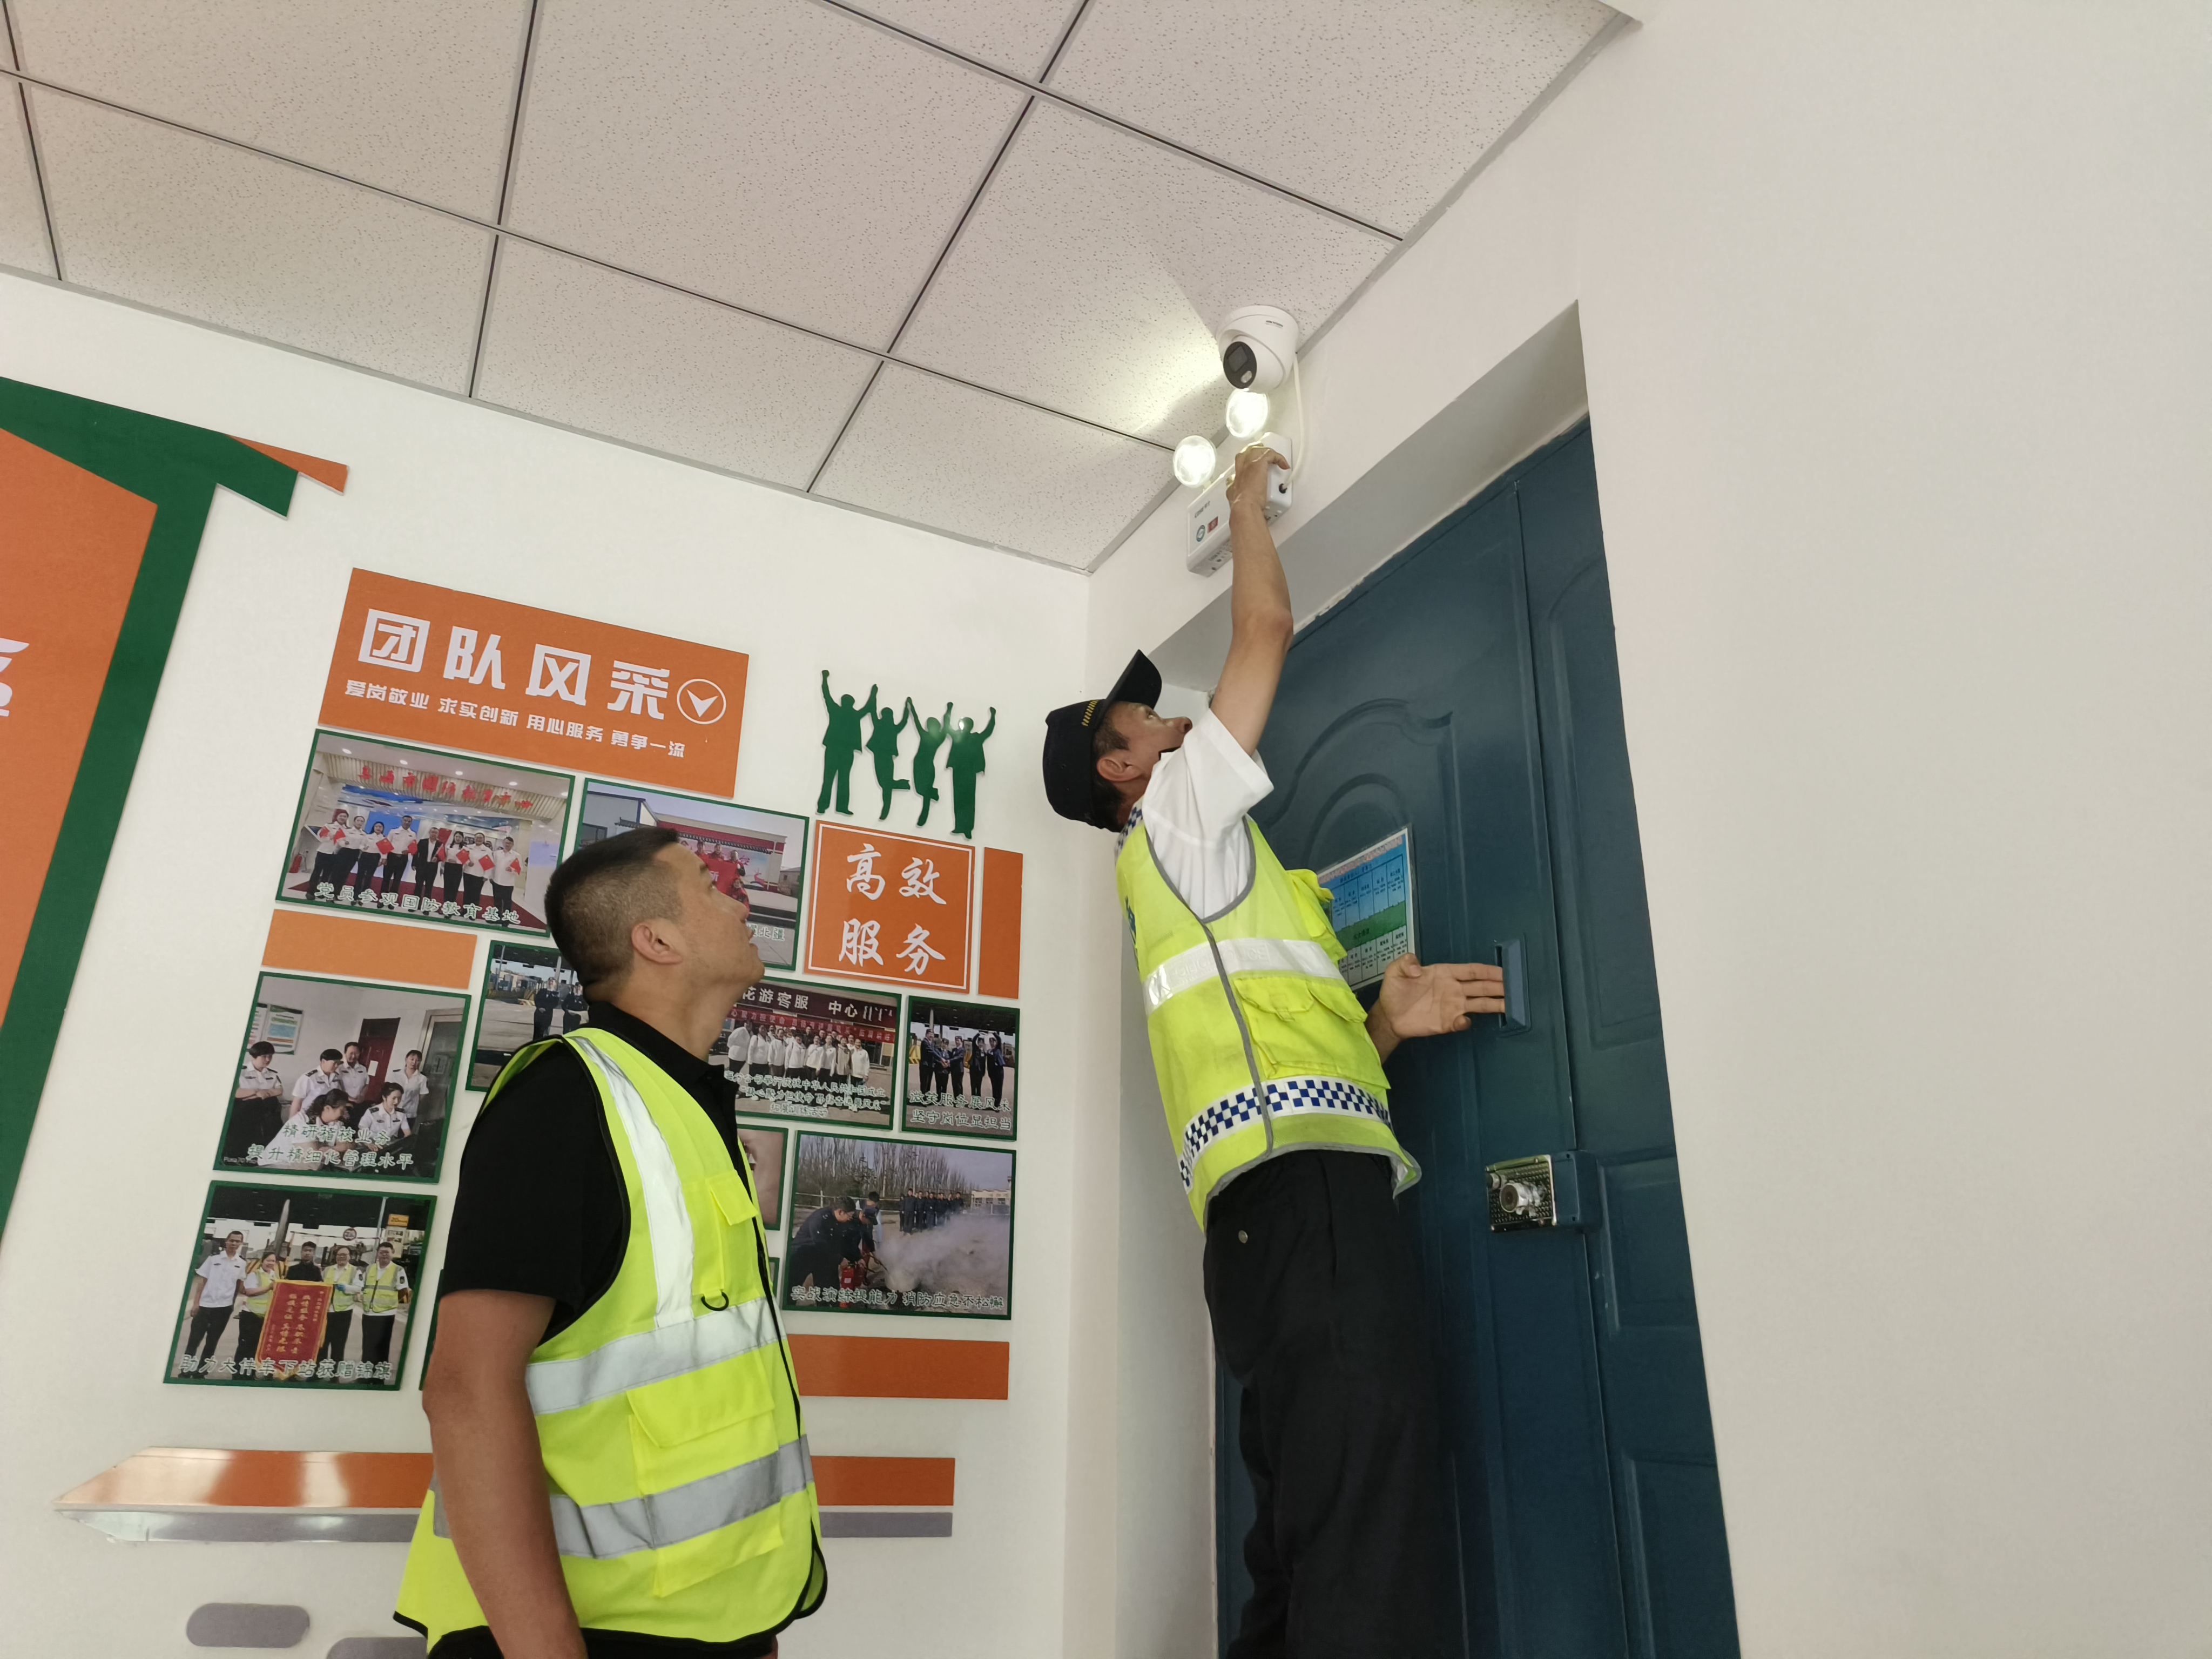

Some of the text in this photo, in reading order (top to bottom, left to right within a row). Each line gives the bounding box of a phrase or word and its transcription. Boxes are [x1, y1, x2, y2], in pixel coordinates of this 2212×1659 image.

[358, 609, 670, 720] 团队风采
[345, 679, 686, 758] 爱岗敬业 求实创新 用心服务 勇争一流
[846, 842, 947, 905] 高效
[314, 882, 521, 925] 党员参观国防教育基地
[838, 918, 946, 975] 服务
[828, 1001, 858, 1018] 中心
[909, 1091, 1011, 1111] 微笑服务展风采
[910, 1109, 1011, 1131] 坚守岗位显担当
[282, 1123, 392, 1145] 精研稽核业务
[246, 1143, 414, 1171] 提升精细化管理水平
[790, 1285, 1005, 1310] 实战演练提能力 消防应急不松懈
[178, 1354, 393, 1380] 助力大件车下站获赠锦旗
